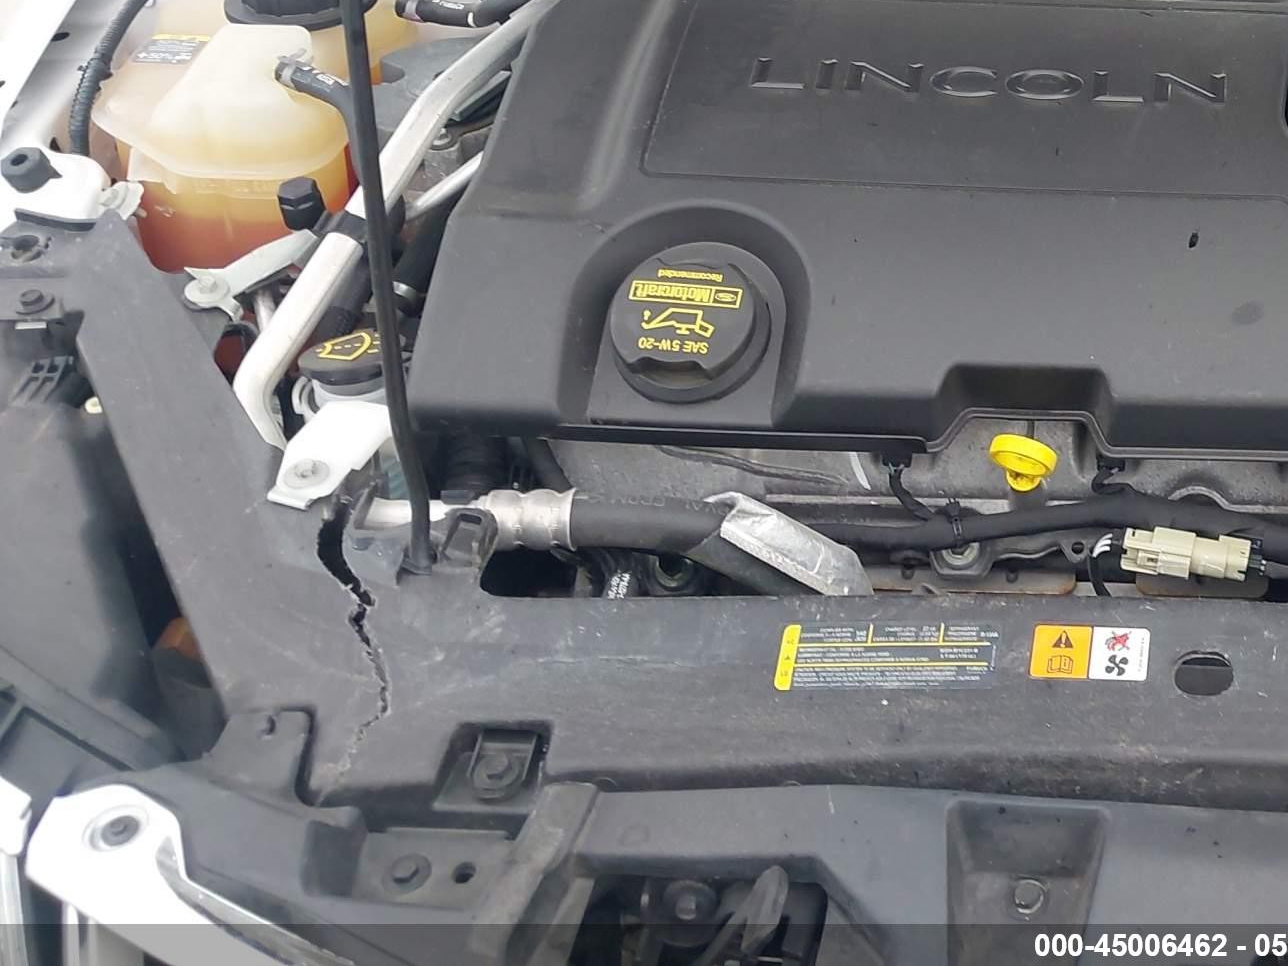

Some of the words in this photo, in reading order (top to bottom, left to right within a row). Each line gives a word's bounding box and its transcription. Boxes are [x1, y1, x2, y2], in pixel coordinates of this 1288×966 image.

[749, 57, 1228, 104] LINCOLN
[657, 269, 723, 282] Recommended
[636, 284, 711, 302] Motorcraft
[638, 337, 681, 351] 5W-20
[682, 341, 709, 354] SAE
